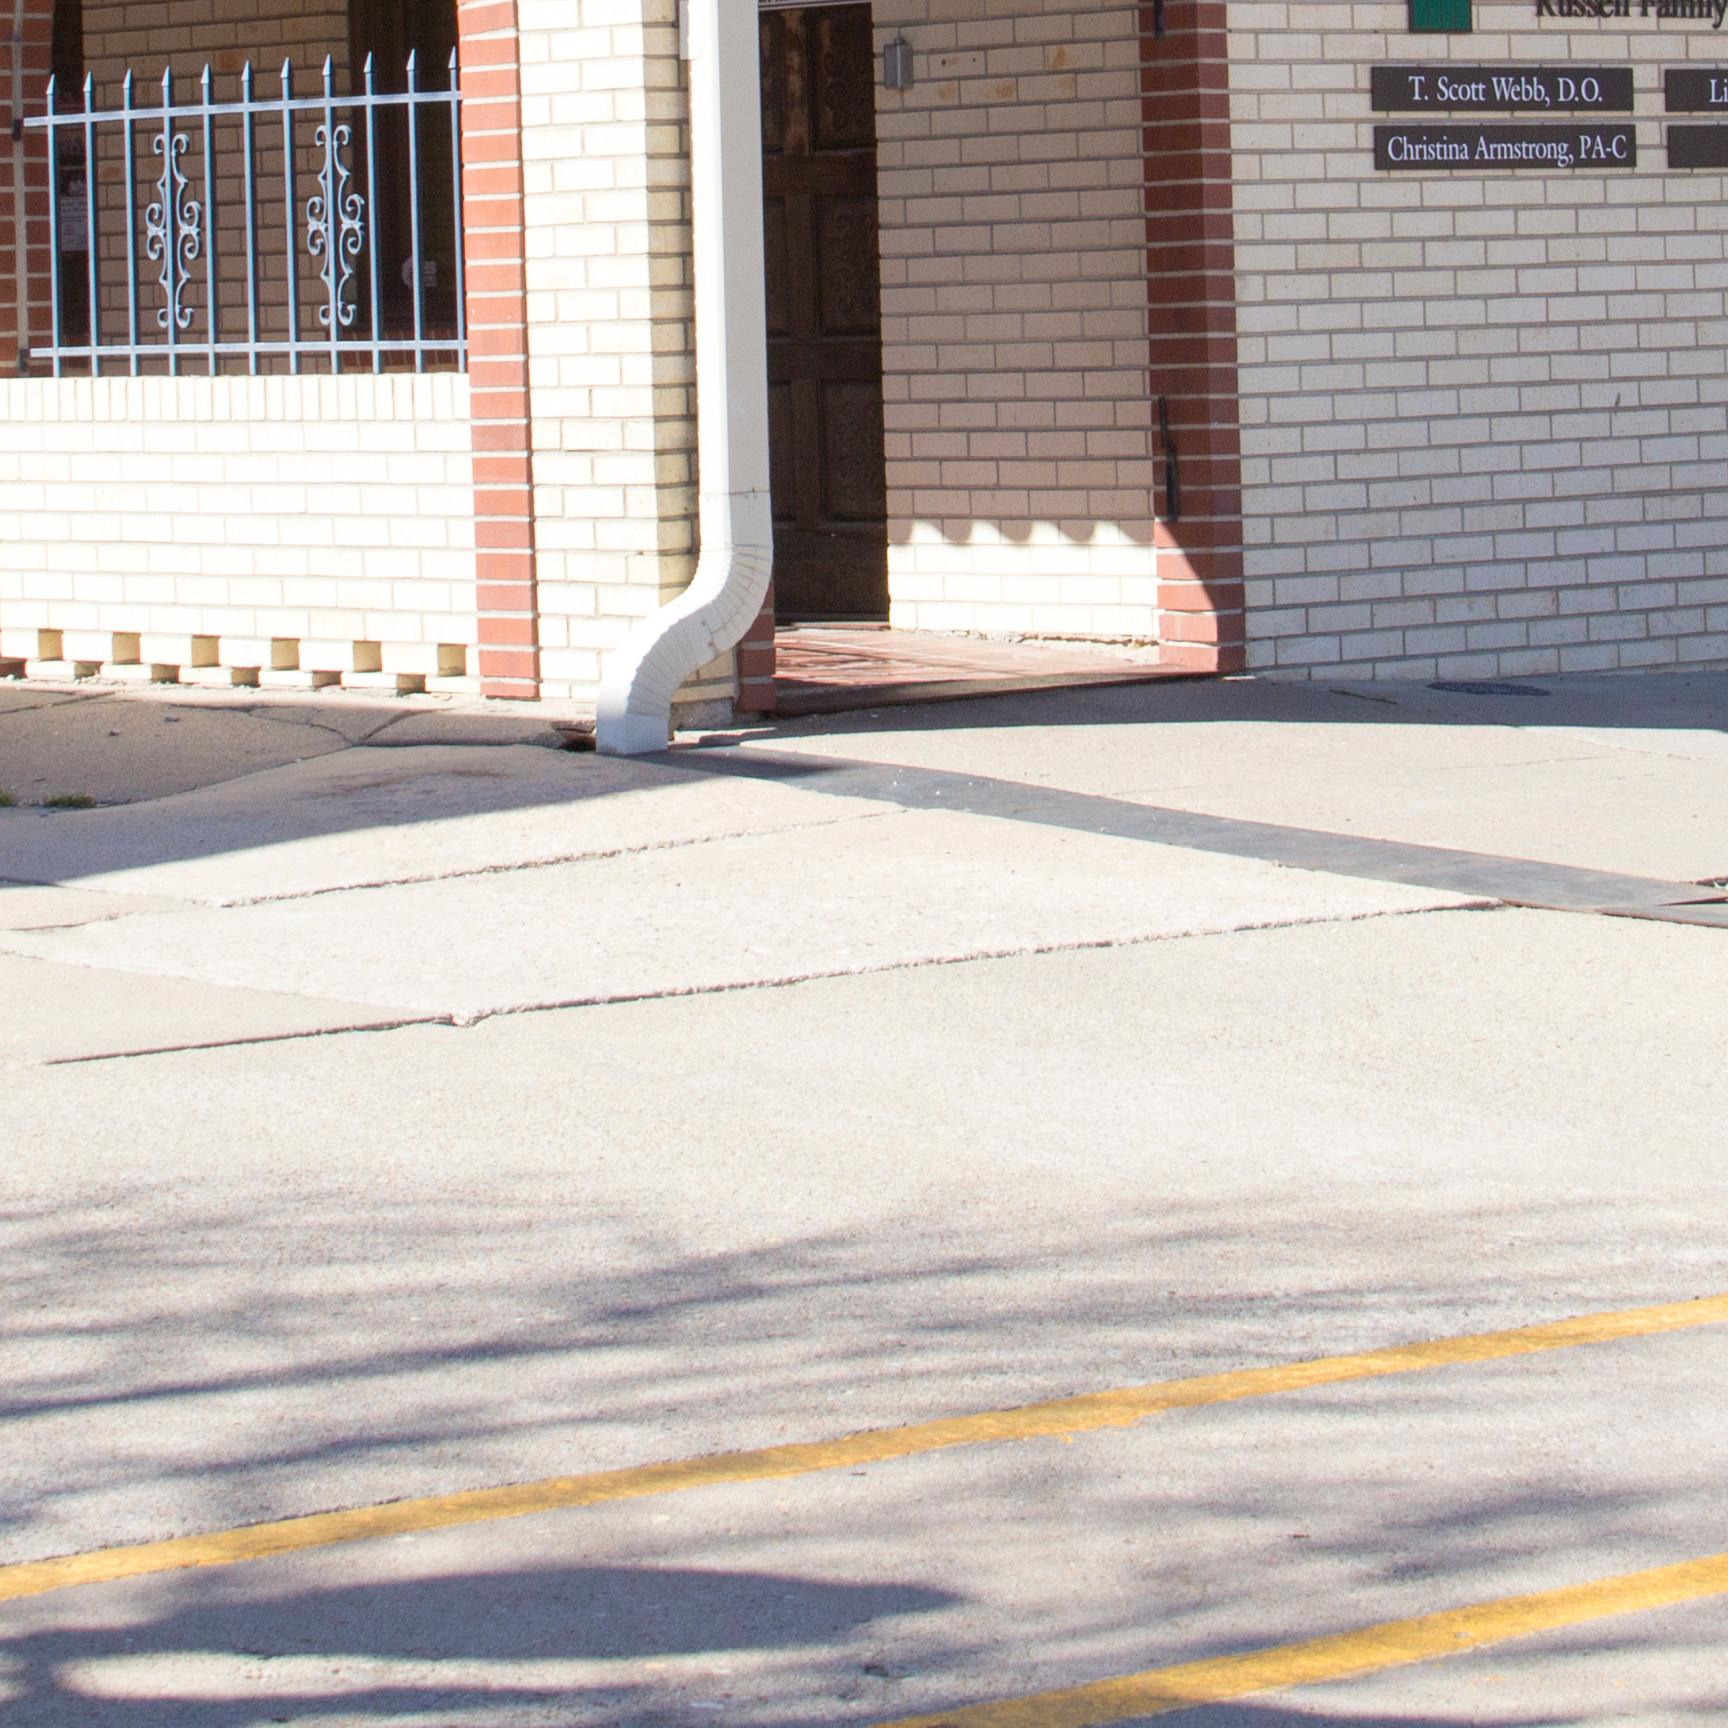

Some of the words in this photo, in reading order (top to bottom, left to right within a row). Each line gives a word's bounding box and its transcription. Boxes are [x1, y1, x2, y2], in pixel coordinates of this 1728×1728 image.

[1408, 75, 1430, 102] T.
[1436, 75, 1487, 102] Scott
[1491, 76, 1551, 108] Webb,
[1557, 77, 1604, 103] D.O.
[1387, 135, 1470, 161] Christina
[1474, 135, 1575, 168] Armstrong,
[1578, 134, 1627, 160] PA-C
